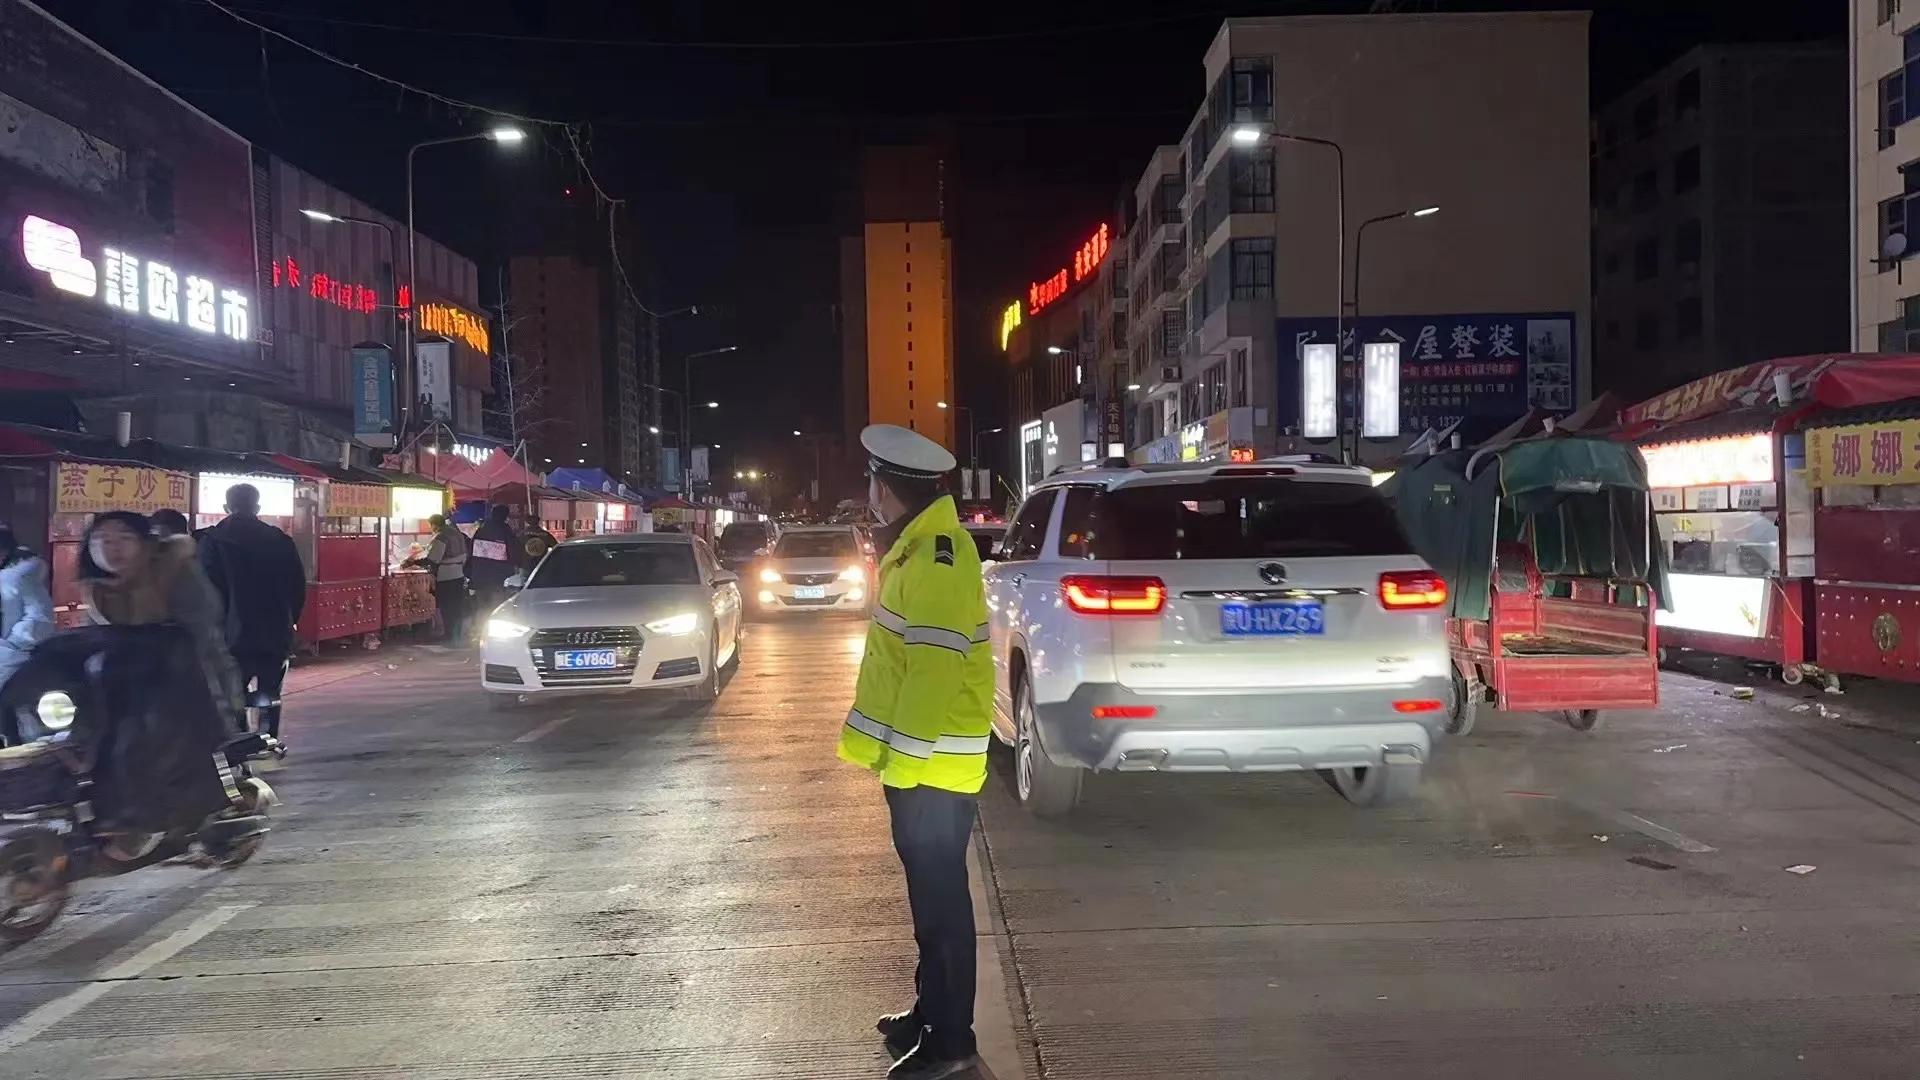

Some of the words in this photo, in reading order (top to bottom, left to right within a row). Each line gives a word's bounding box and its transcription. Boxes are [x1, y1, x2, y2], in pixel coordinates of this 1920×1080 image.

[1831, 430, 1920, 478] 娜娜
[60, 463, 189, 501] 燕子炒面
